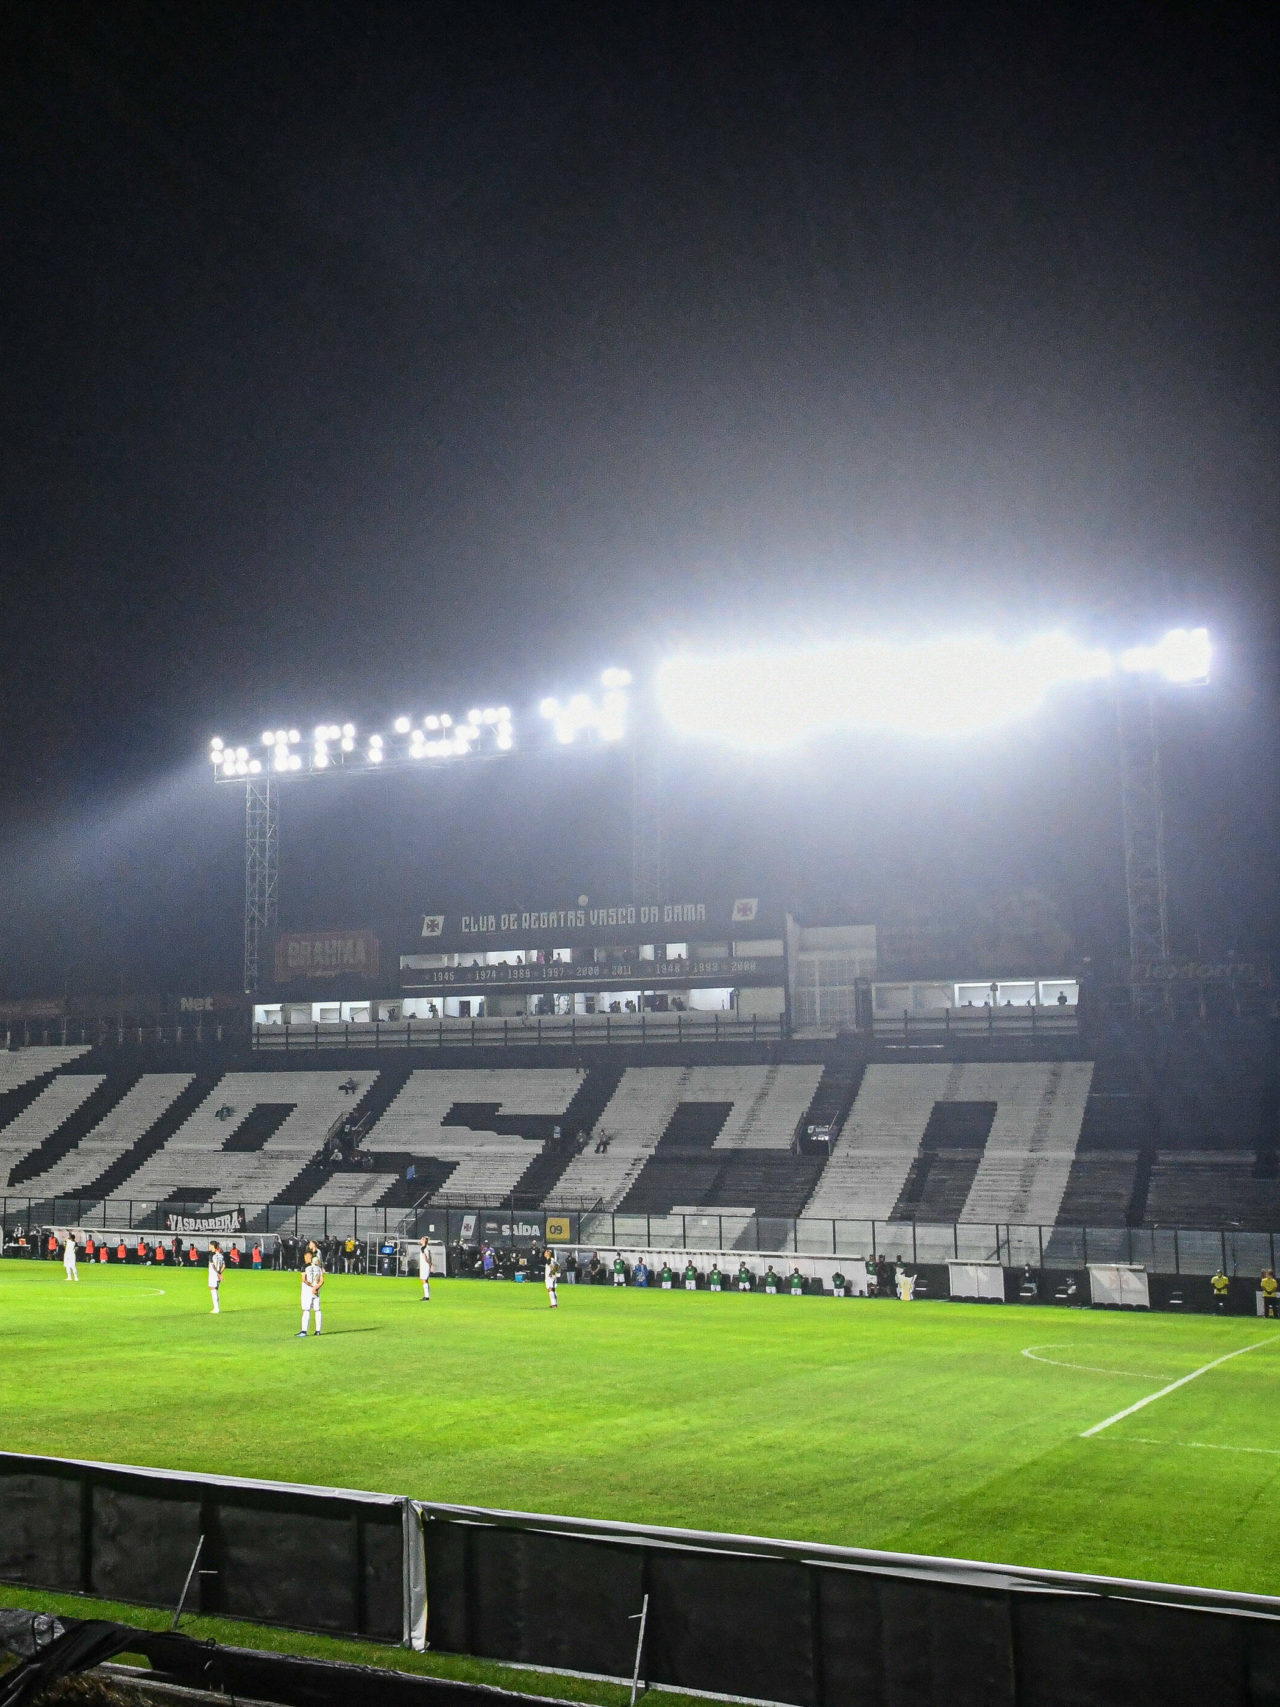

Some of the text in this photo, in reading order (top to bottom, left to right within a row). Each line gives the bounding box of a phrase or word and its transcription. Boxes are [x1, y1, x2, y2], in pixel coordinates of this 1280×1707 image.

[461, 915, 496, 932] CLUB
[589, 906, 636, 926] VASCO
[168, 1211, 241, 1232] VASBARREIRA
[501, 1222, 541, 1236] SAÍDA
[549, 1224, 563, 1235] 09
